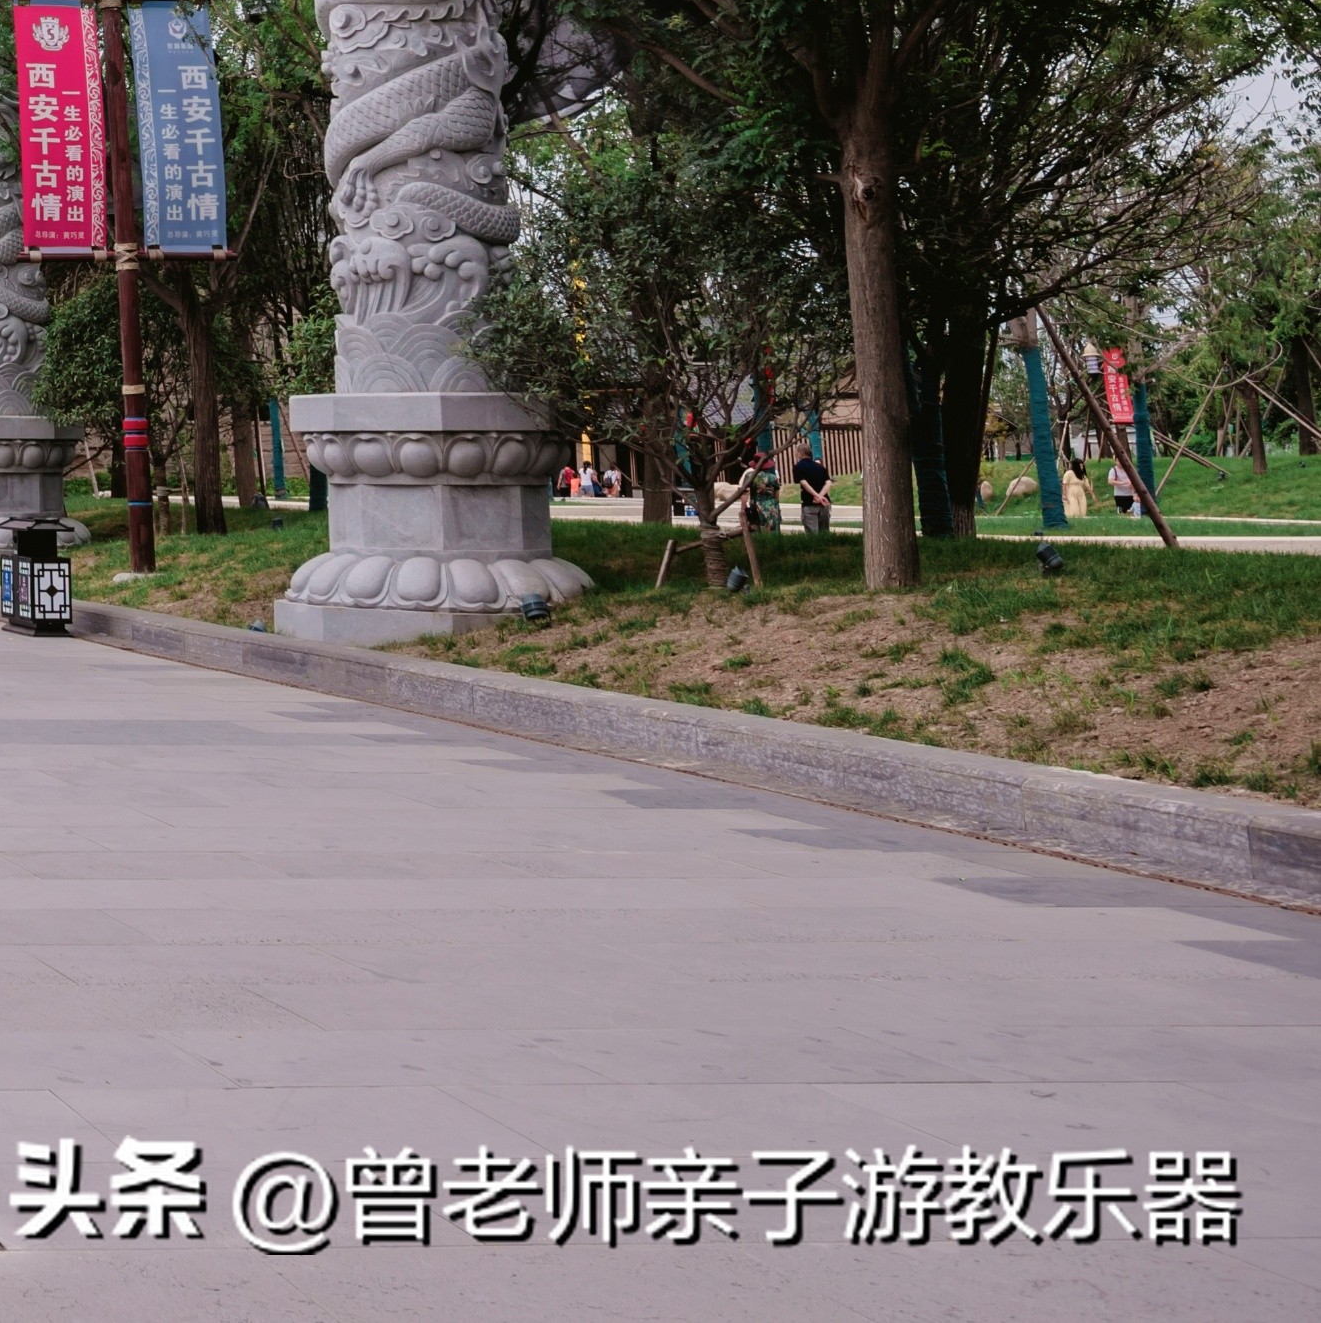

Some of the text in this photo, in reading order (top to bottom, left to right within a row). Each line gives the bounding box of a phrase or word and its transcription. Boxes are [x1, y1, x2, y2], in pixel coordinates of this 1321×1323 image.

[26, 63, 62, 221] 西安千古情
[62, 90, 85, 222] 一生必看的演出
[157, 89, 183, 222] 一生必看的演出
[178, 65, 220, 221] 西安千古情
